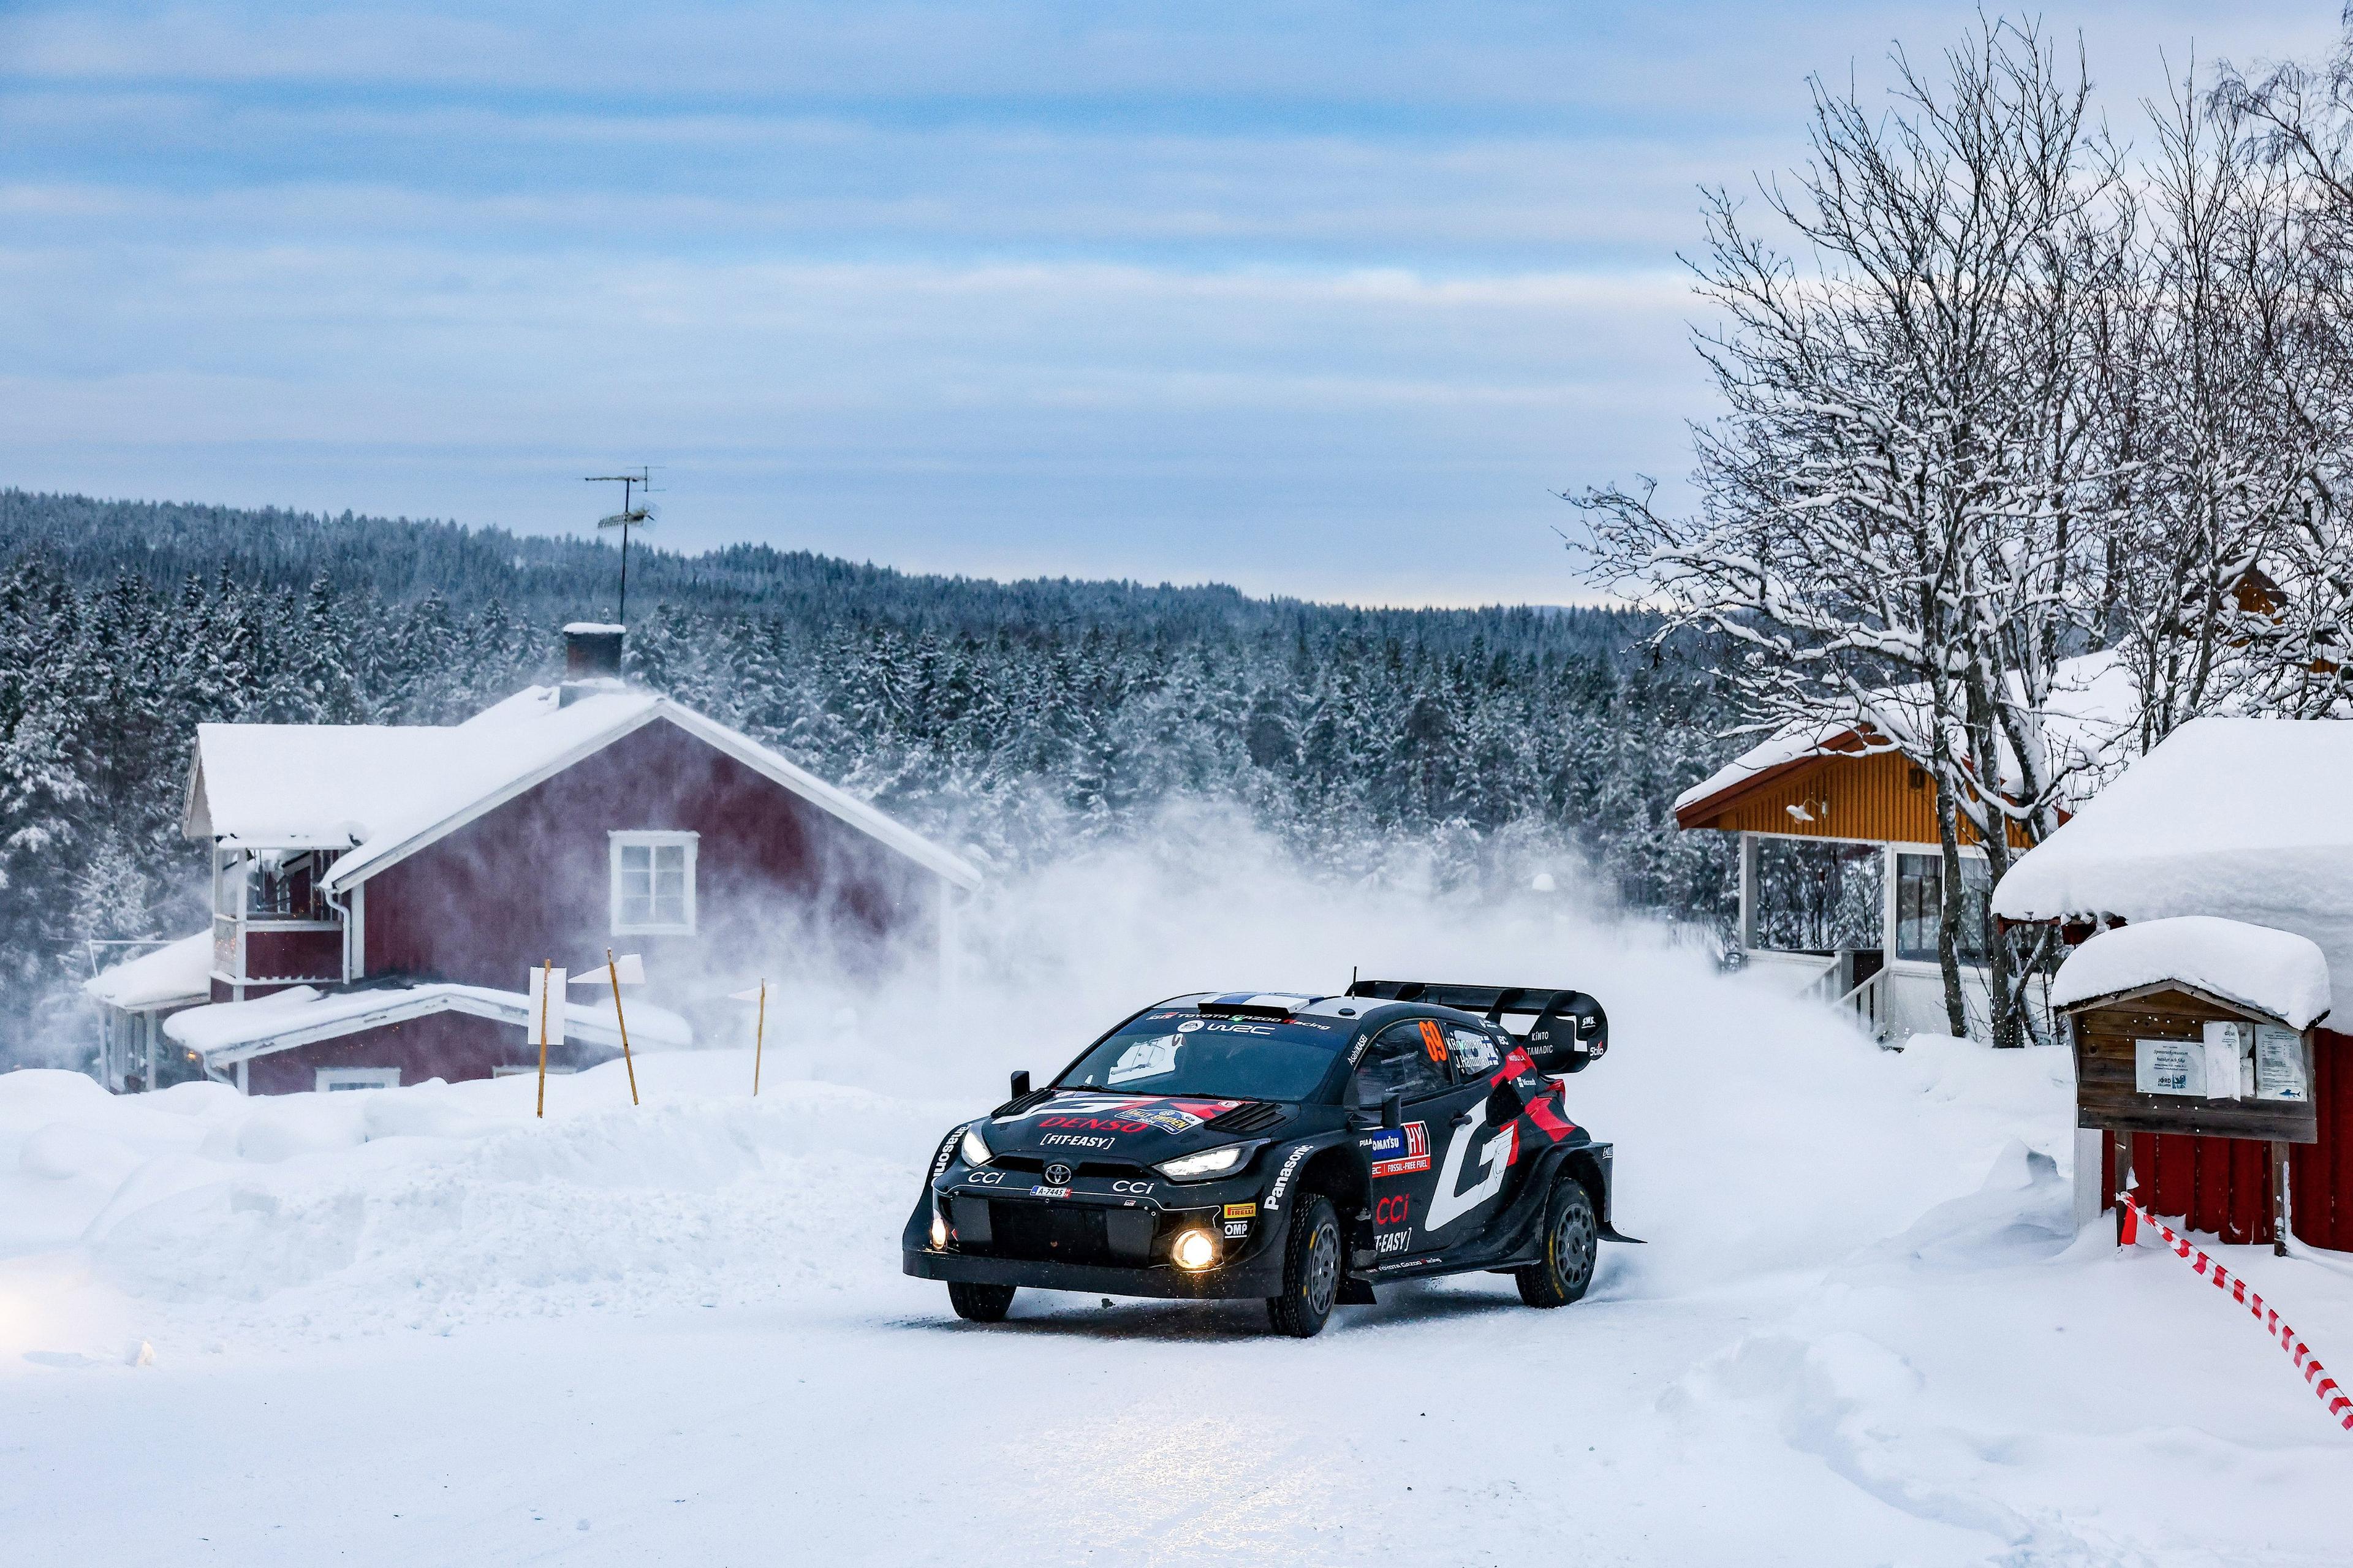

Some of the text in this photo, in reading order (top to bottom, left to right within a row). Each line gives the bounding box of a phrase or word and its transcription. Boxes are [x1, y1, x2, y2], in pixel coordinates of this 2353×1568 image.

[1207, 1023, 1276, 1036] WRC
[1282, 1018, 1331, 1031] Racing
[1418, 1021, 1448, 1062] 69
[1526, 1045, 1554, 1056] TAMADIC
[1590, 1042, 1604, 1057] Stilo
[1039, 1117, 1149, 1133] DENSO
[1151, 1114, 1189, 1129] SWEDEN
[1359, 1138, 1372, 1147] PIAA
[1372, 1135, 1400, 1151] OMATSU
[1407, 1126, 1423, 1154] HY
[1387, 1161, 1416, 1173] FOSSIL-FREE
[1416, 1159, 1428, 1169] FUEL
[1264, 1145, 1314, 1210] Panasonic
[1038, 1187, 1064, 1196] A-7445
[1227, 1206, 1254, 1216] PIRELLI
[1224, 1223, 1248, 1236] OMP
